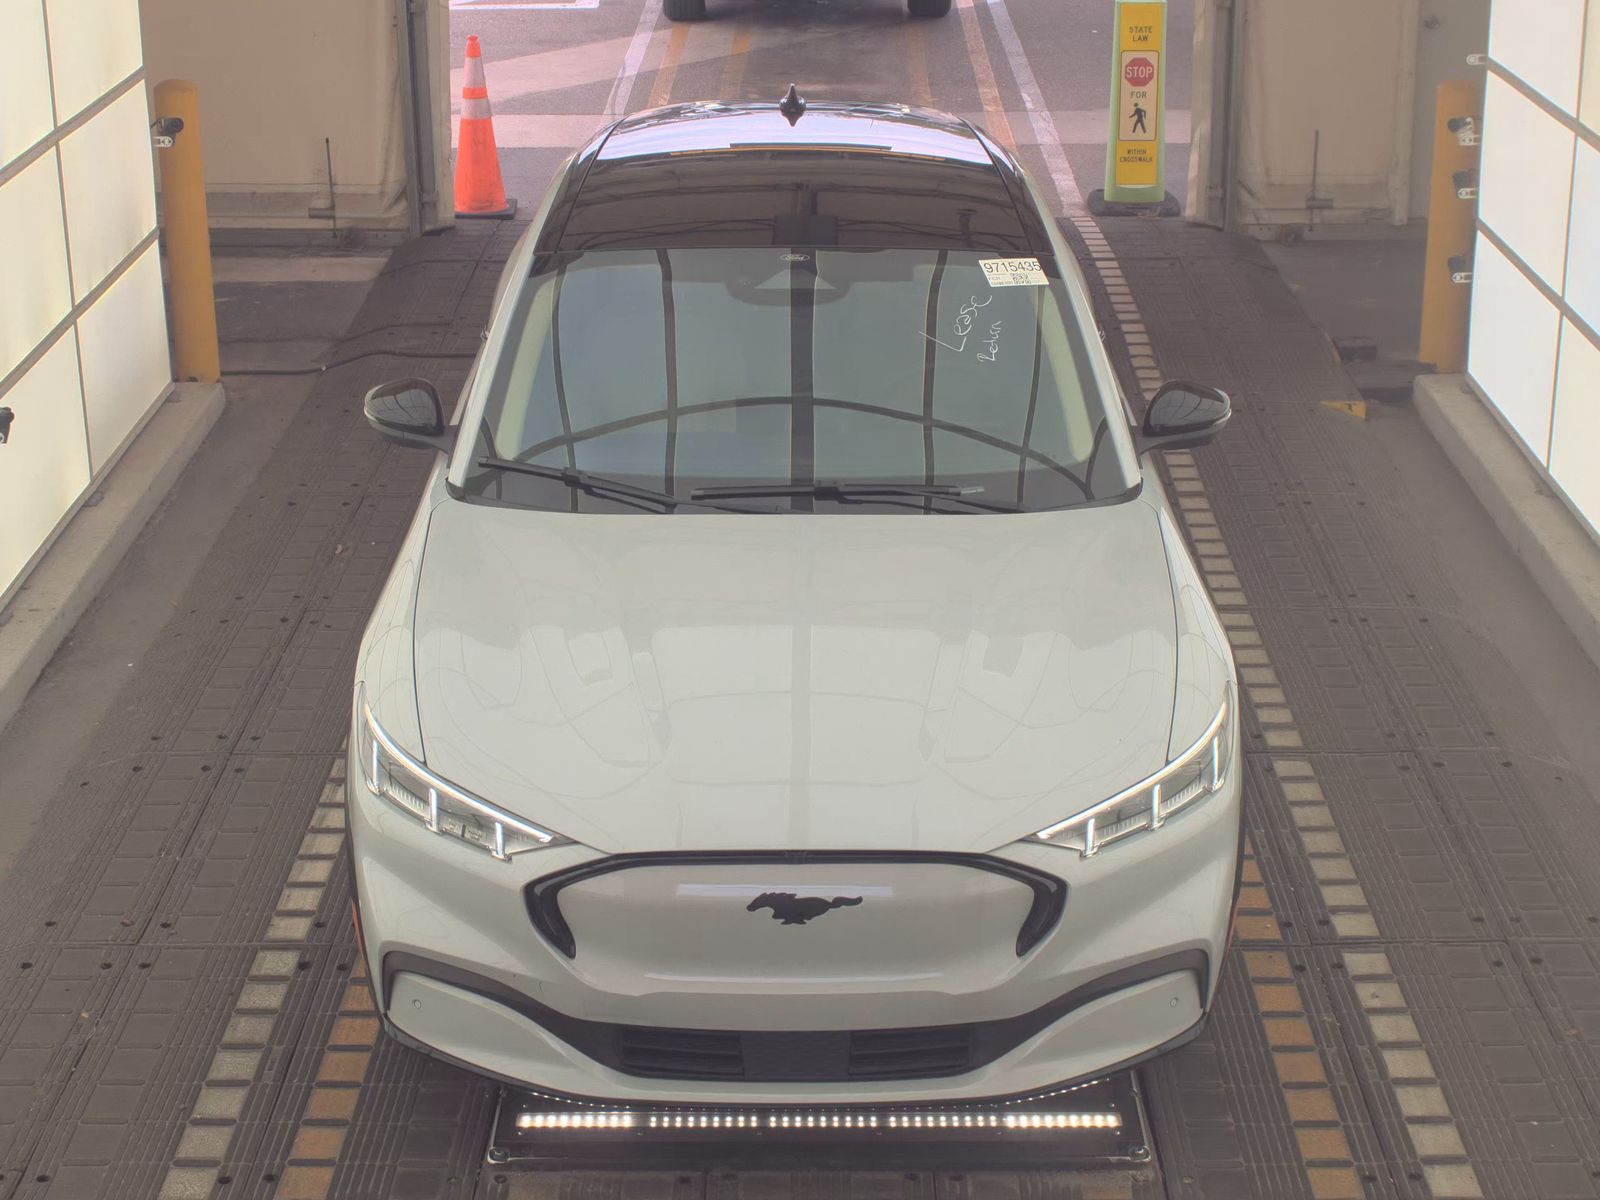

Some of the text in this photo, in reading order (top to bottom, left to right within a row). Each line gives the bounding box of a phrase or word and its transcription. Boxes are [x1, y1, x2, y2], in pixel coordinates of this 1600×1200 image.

[1128, 25, 1153, 33] STATE
[1132, 34, 1149, 42] LAW
[1126, 66, 1153, 78] STOP
[1130, 90, 1147, 99] FOR
[983, 261, 1041, 274] 9715435
[918, 295, 992, 352] Lease
